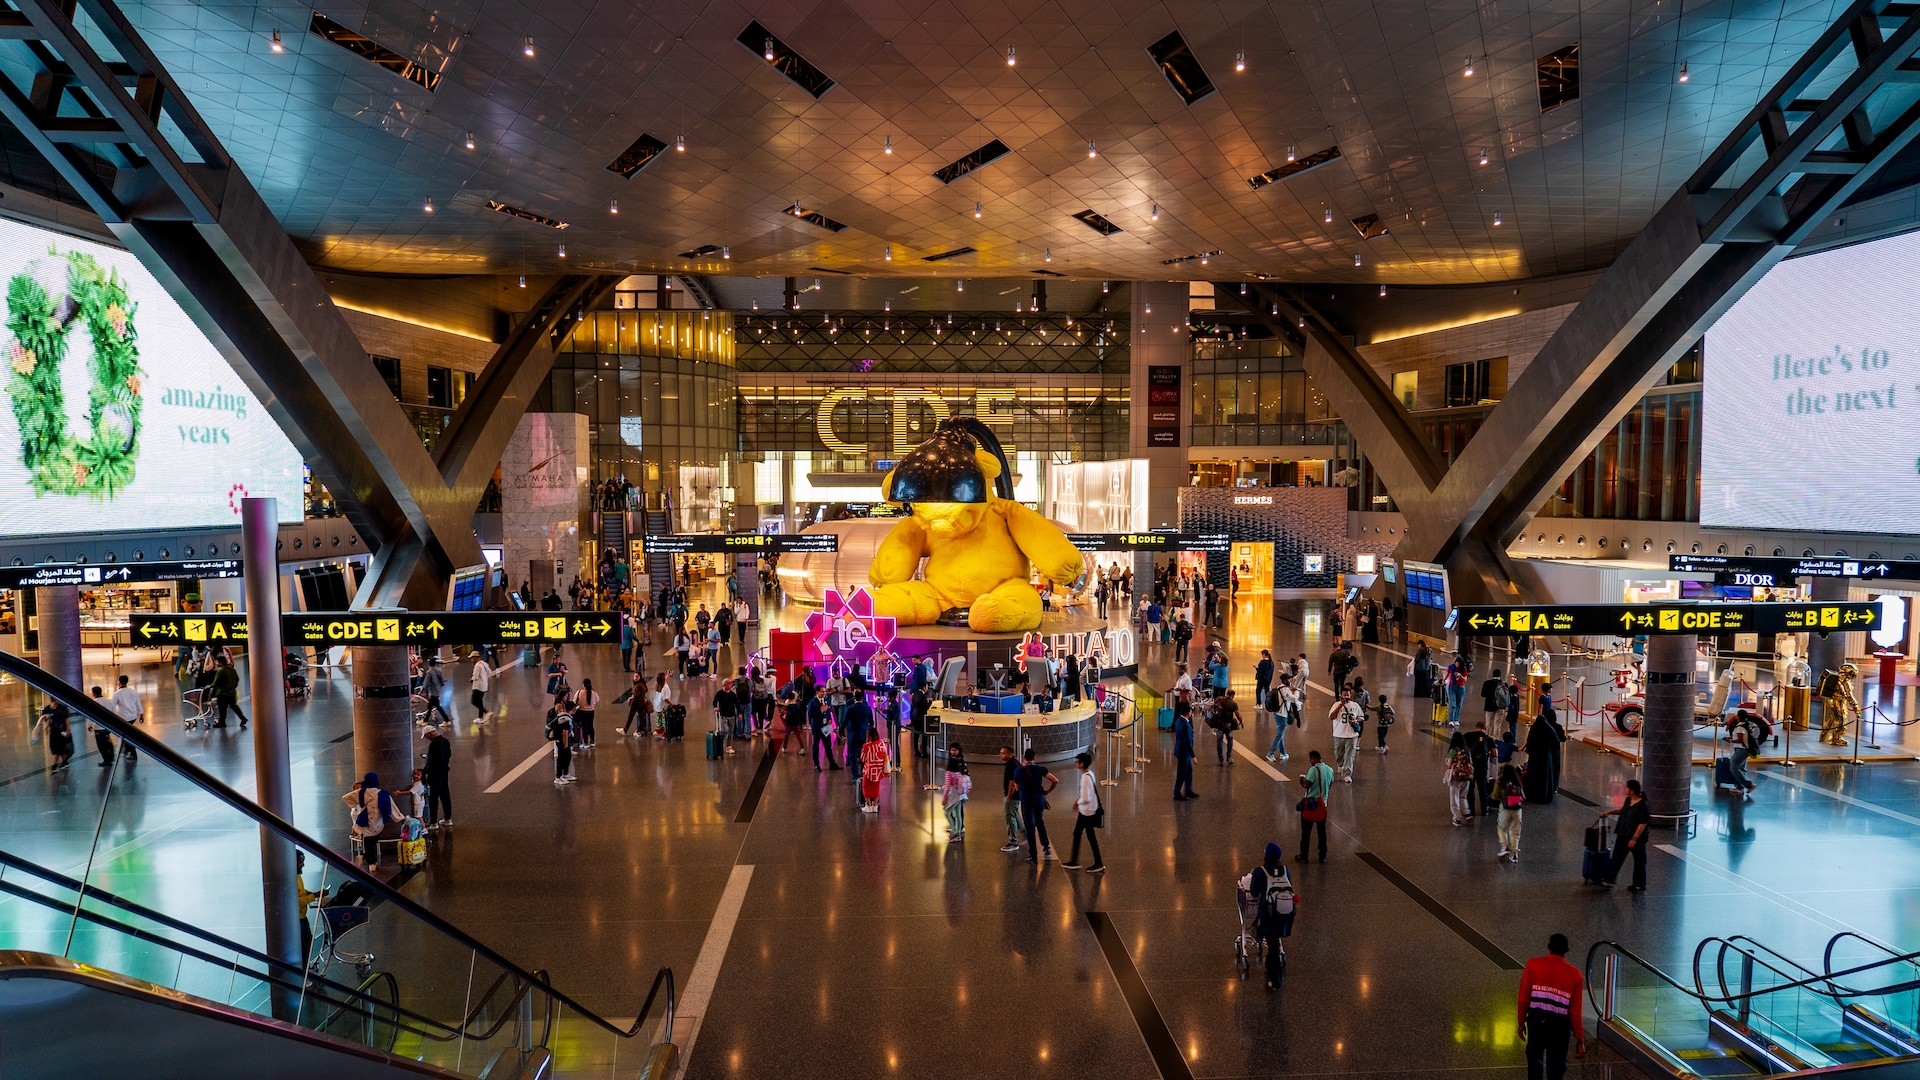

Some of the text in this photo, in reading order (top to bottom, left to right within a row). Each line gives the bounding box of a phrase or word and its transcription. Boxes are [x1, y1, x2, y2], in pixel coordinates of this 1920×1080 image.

[1772, 345, 1889, 381] Here's to
[161, 385, 247, 419] amazing
[1787, 383, 1896, 415] the next
[178, 423, 231, 450] years
[734, 537, 755, 545] CDE
[1138, 535, 1157, 544] CDE
[28, 578, 56, 586] Mourjan
[57, 577, 82, 585] Lounge
[1735, 574, 1774, 586] DIOR
[1534, 613, 1549, 629] A
[1554, 614, 1573, 622] بوابات
[1682, 611, 1721, 628] CDE
[1724, 611, 1743, 620] بوابات
[1805, 610, 1818, 626] B
[211, 622, 228, 639] A
[302, 622, 324, 631] بوابات
[327, 621, 373, 639] CDE
[499, 620, 520, 629] بوابات
[524, 620, 540, 638] B
